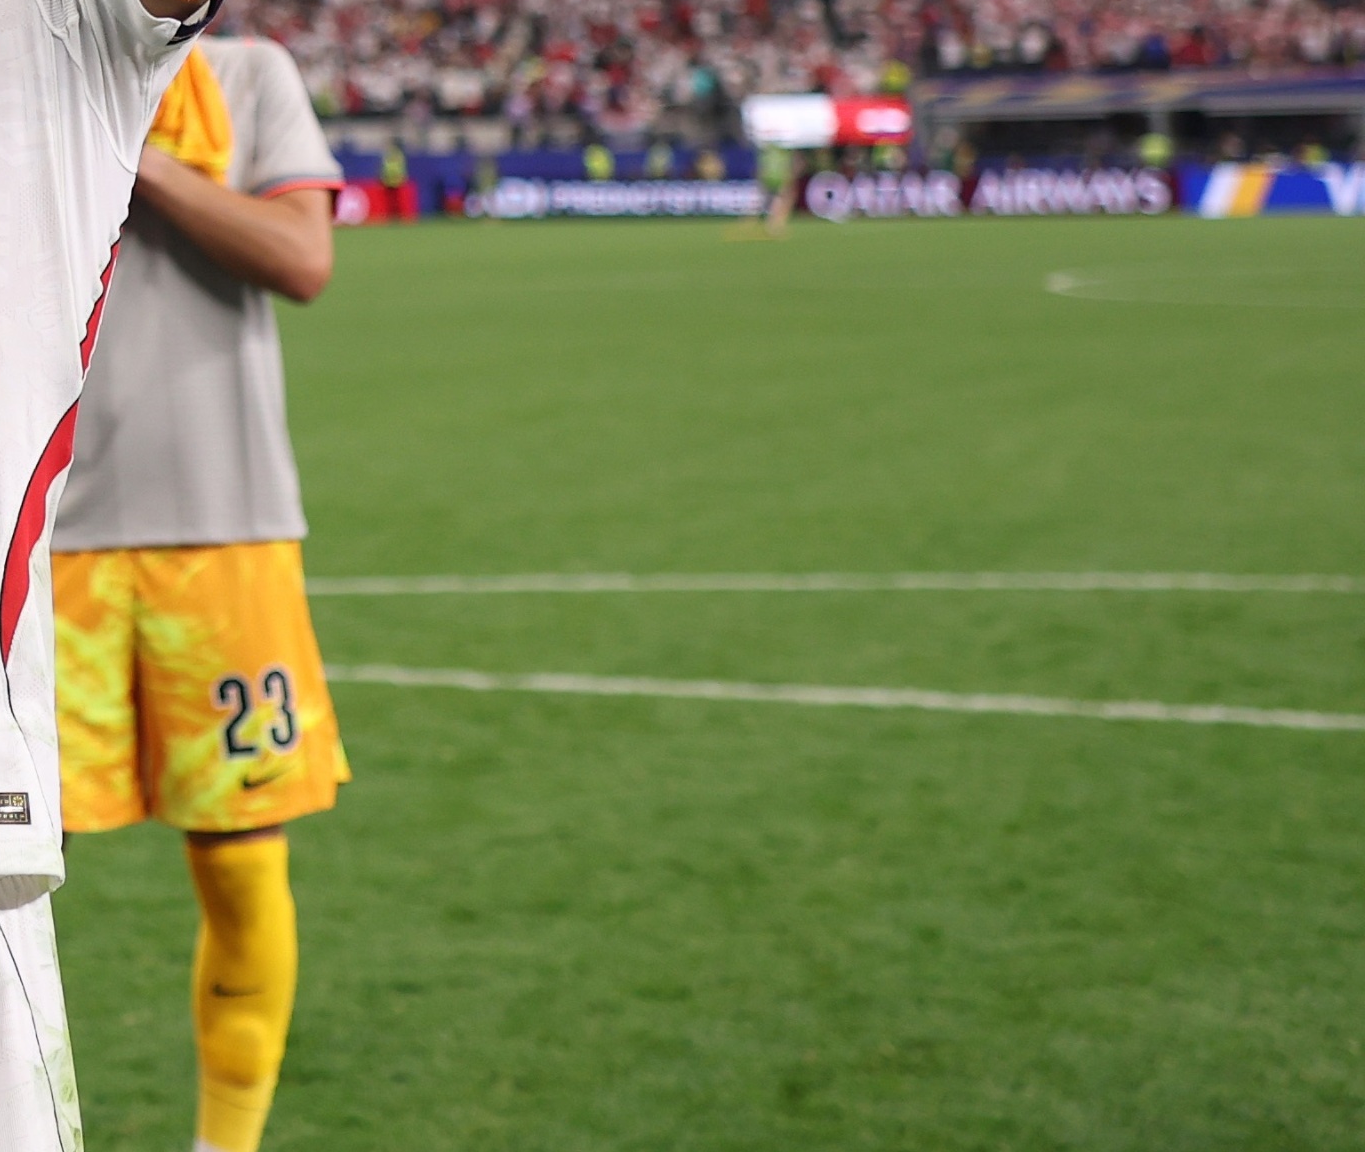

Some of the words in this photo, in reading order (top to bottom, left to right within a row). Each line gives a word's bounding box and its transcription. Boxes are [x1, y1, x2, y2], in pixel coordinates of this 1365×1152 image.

[806, 171, 963, 223] QATAR
[970, 167, 1172, 215] AIRWAYS
[215, 668, 297, 757] 23
